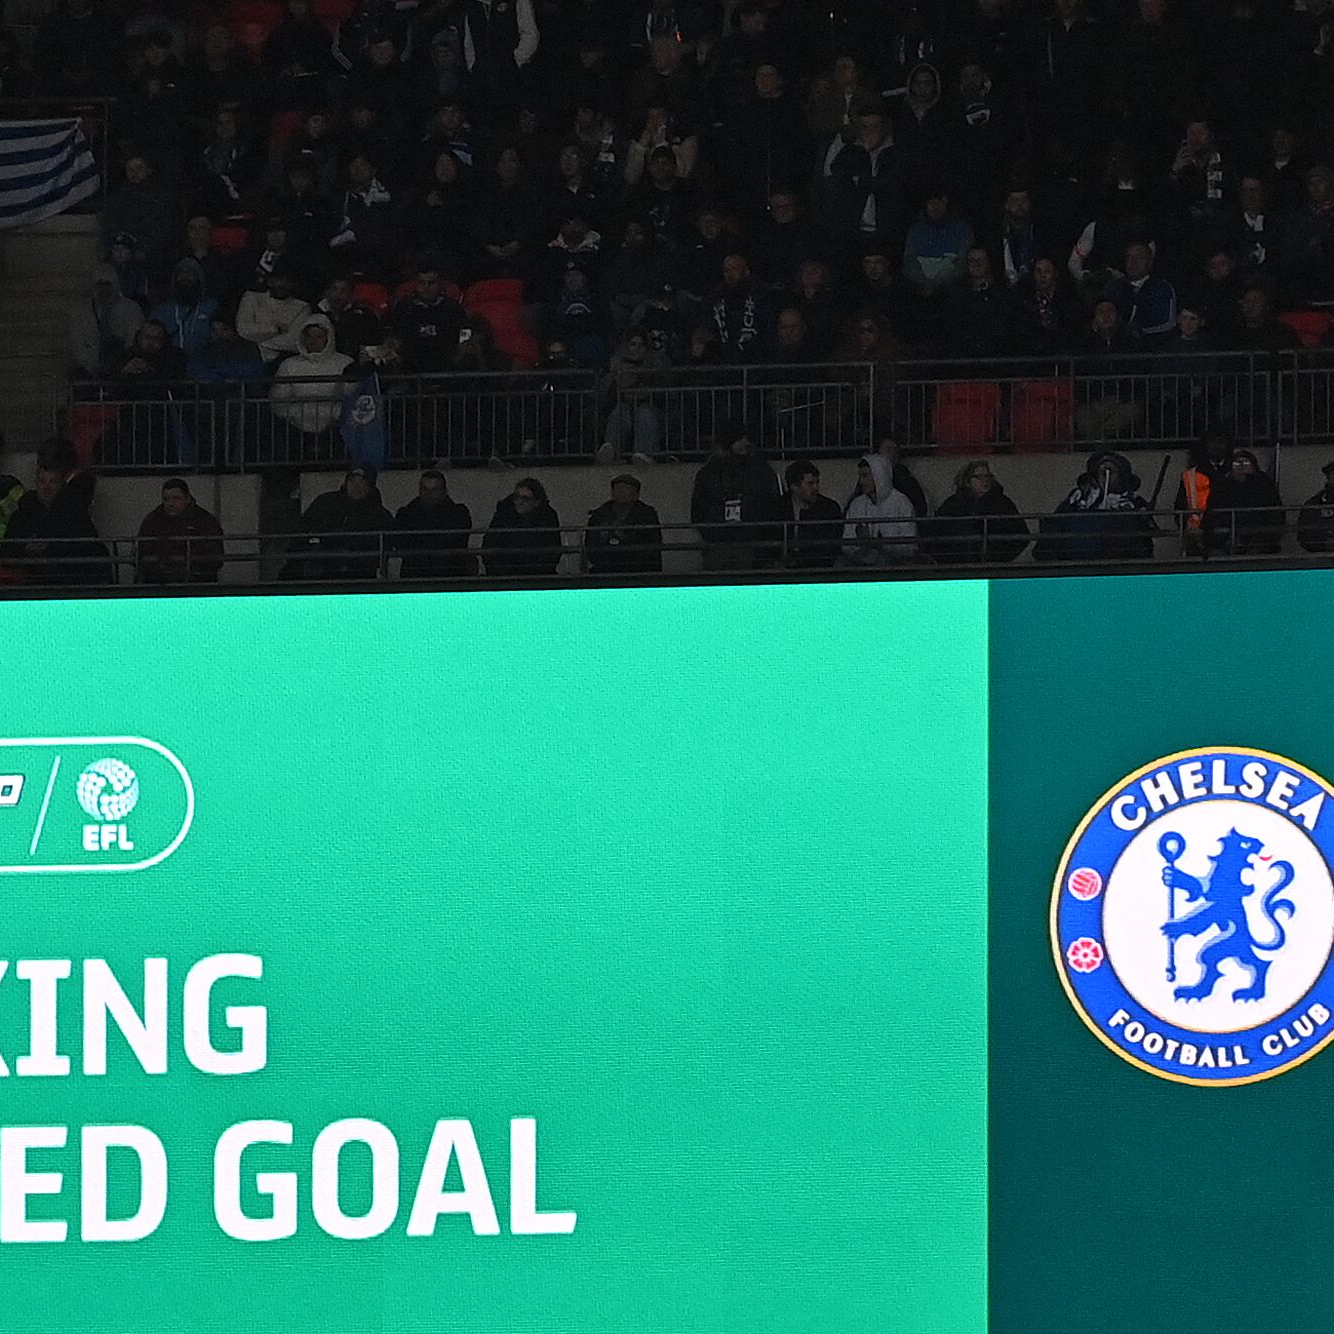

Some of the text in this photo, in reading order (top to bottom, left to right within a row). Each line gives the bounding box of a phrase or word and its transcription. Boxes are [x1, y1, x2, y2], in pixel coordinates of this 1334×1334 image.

[1110, 759, 1326, 832] CHELSEA
[83, 825, 135, 852] EFL
[1108, 1003, 1331, 1068] FOOTBALL CLUB
[214, 1118, 578, 1242] GOAL
